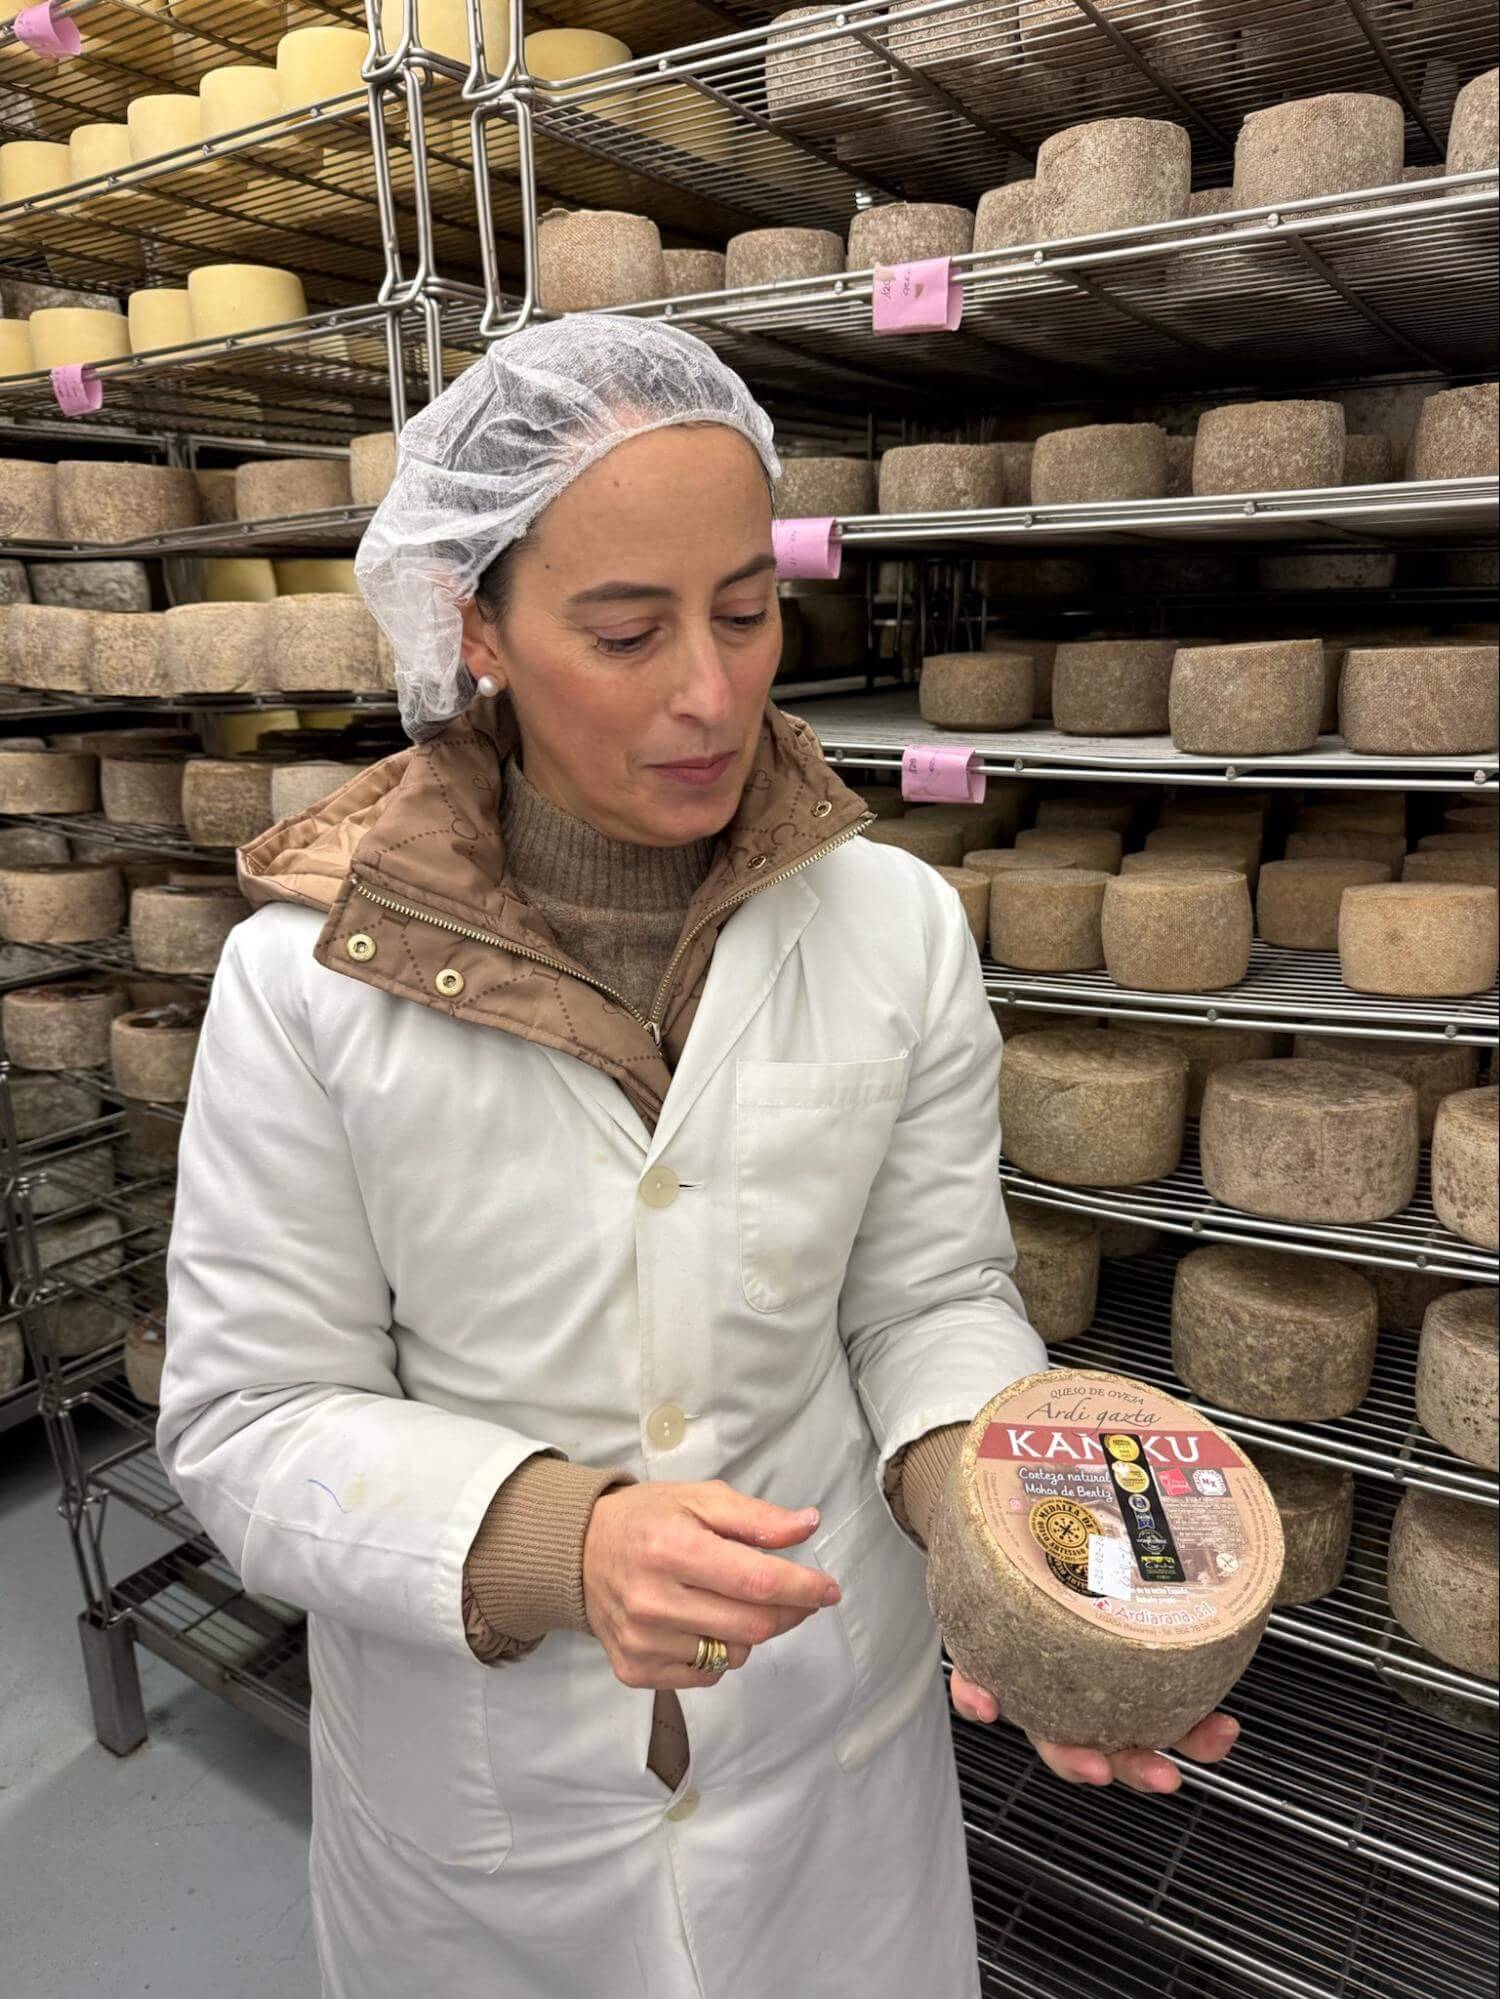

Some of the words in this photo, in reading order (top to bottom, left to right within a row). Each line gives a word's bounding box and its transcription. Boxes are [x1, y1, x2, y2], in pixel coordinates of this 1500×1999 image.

[1050, 1387, 1086, 1399] QUESO
[1088, 1387, 1105, 1397] DE
[1027, 1397, 1092, 1421] Ardi
[1072, 1409, 1161, 1438] gazta
[1006, 1429, 1200, 1463] KANKU
[1019, 1467, 1065, 1486] Corteza
[1067, 1470, 1111, 1483] natural
[1025, 1483, 1058, 1496] Mohos
[1061, 1485, 1075, 1496] de
[1076, 1485, 1112, 1503] Bertiz
[1039, 1503, 1080, 1520] MEDALLA
[1082, 1516, 1093, 1529] DE
[1115, 1606, 1195, 1626] Ardiarana,
